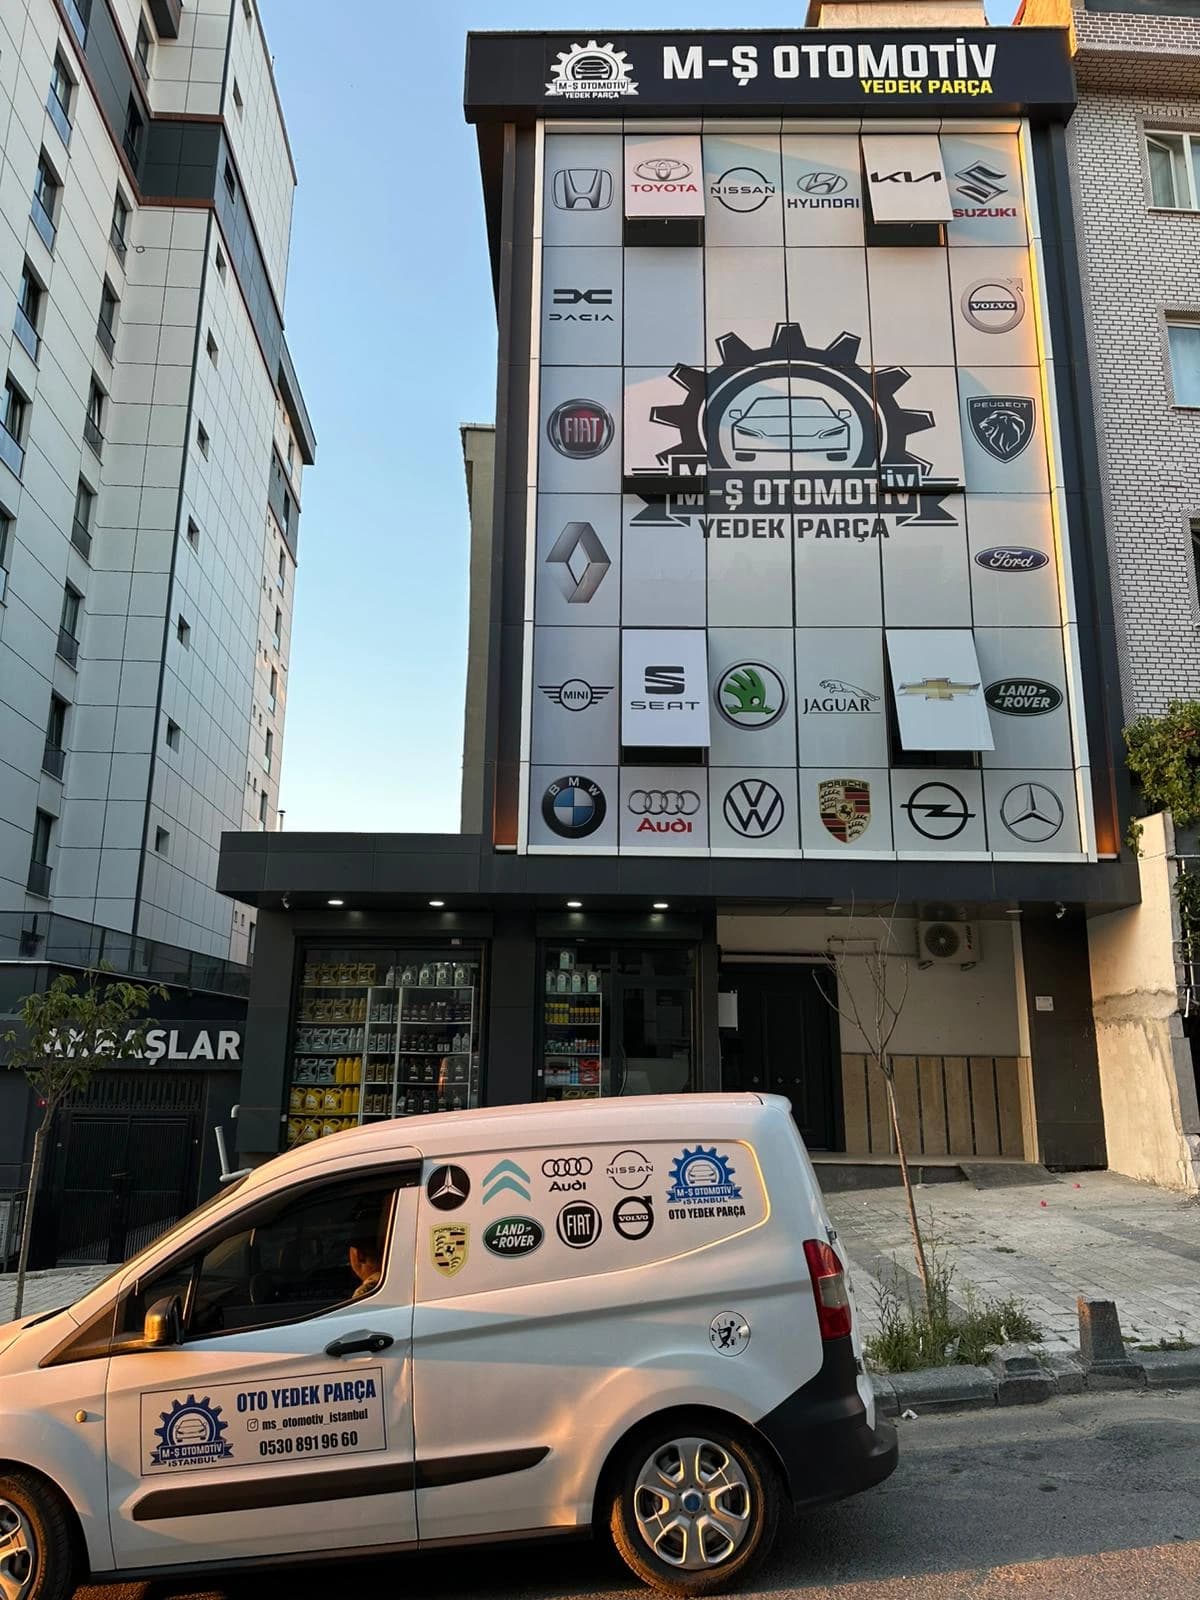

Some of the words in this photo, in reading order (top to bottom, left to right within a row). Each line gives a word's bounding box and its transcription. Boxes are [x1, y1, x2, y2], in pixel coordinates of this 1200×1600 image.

[663, 45, 758, 86] M-Ş
[773, 38, 996, 79] OTOMOTİV
[860, 79, 922, 94] YEDEK
[928, 79, 993, 96] PARÇA
[631, 184, 698, 193] TOYOTA
[710, 185, 775, 194] NISSAN
[787, 199, 860, 209] HYUNDAI
[952, 207, 1017, 218] SUZUKI
[971, 302, 1015, 311] VOLVO
[549, 313, 614, 321] DACIA
[973, 400, 1029, 409] PEUGEOT
[564, 416, 600, 443] FIAT
[699, 518, 785, 539] YEDEK
[797, 518, 890, 542] PARÇA
[989, 550, 1034, 568] Ford
[563, 690, 589, 701] MINI
[999, 685, 1037, 697] LAND
[630, 701, 701, 711] SEAT
[803, 698, 871, 715] JAGUAR
[1003, 697, 1051, 709] ROVER
[548, 776, 602, 797] BMW
[636, 818, 693, 833] Audi
[606, 1165, 654, 1175] NISSAN
[548, 1179, 587, 1193] Audi
[618, 1213, 649, 1222] VOLVO
[668, 1208, 686, 1220] OTO
[687, 1206, 715, 1219] YEDEK
[716, 1205, 746, 1218] PARÇA
[496, 1223, 523, 1237] LAND
[566, 1213, 591, 1237] FIAT
[498, 1234, 535, 1249] ROVER
[236, 1390, 268, 1413] OTO
[271, 1385, 321, 1409] YEDEK
[323, 1379, 377, 1403] PARÇA
[259, 1438, 293, 1456] 0530
[296, 1435, 319, 1452] 891
[322, 1433, 338, 1449] 96
[341, 1430, 358, 1447] 60
